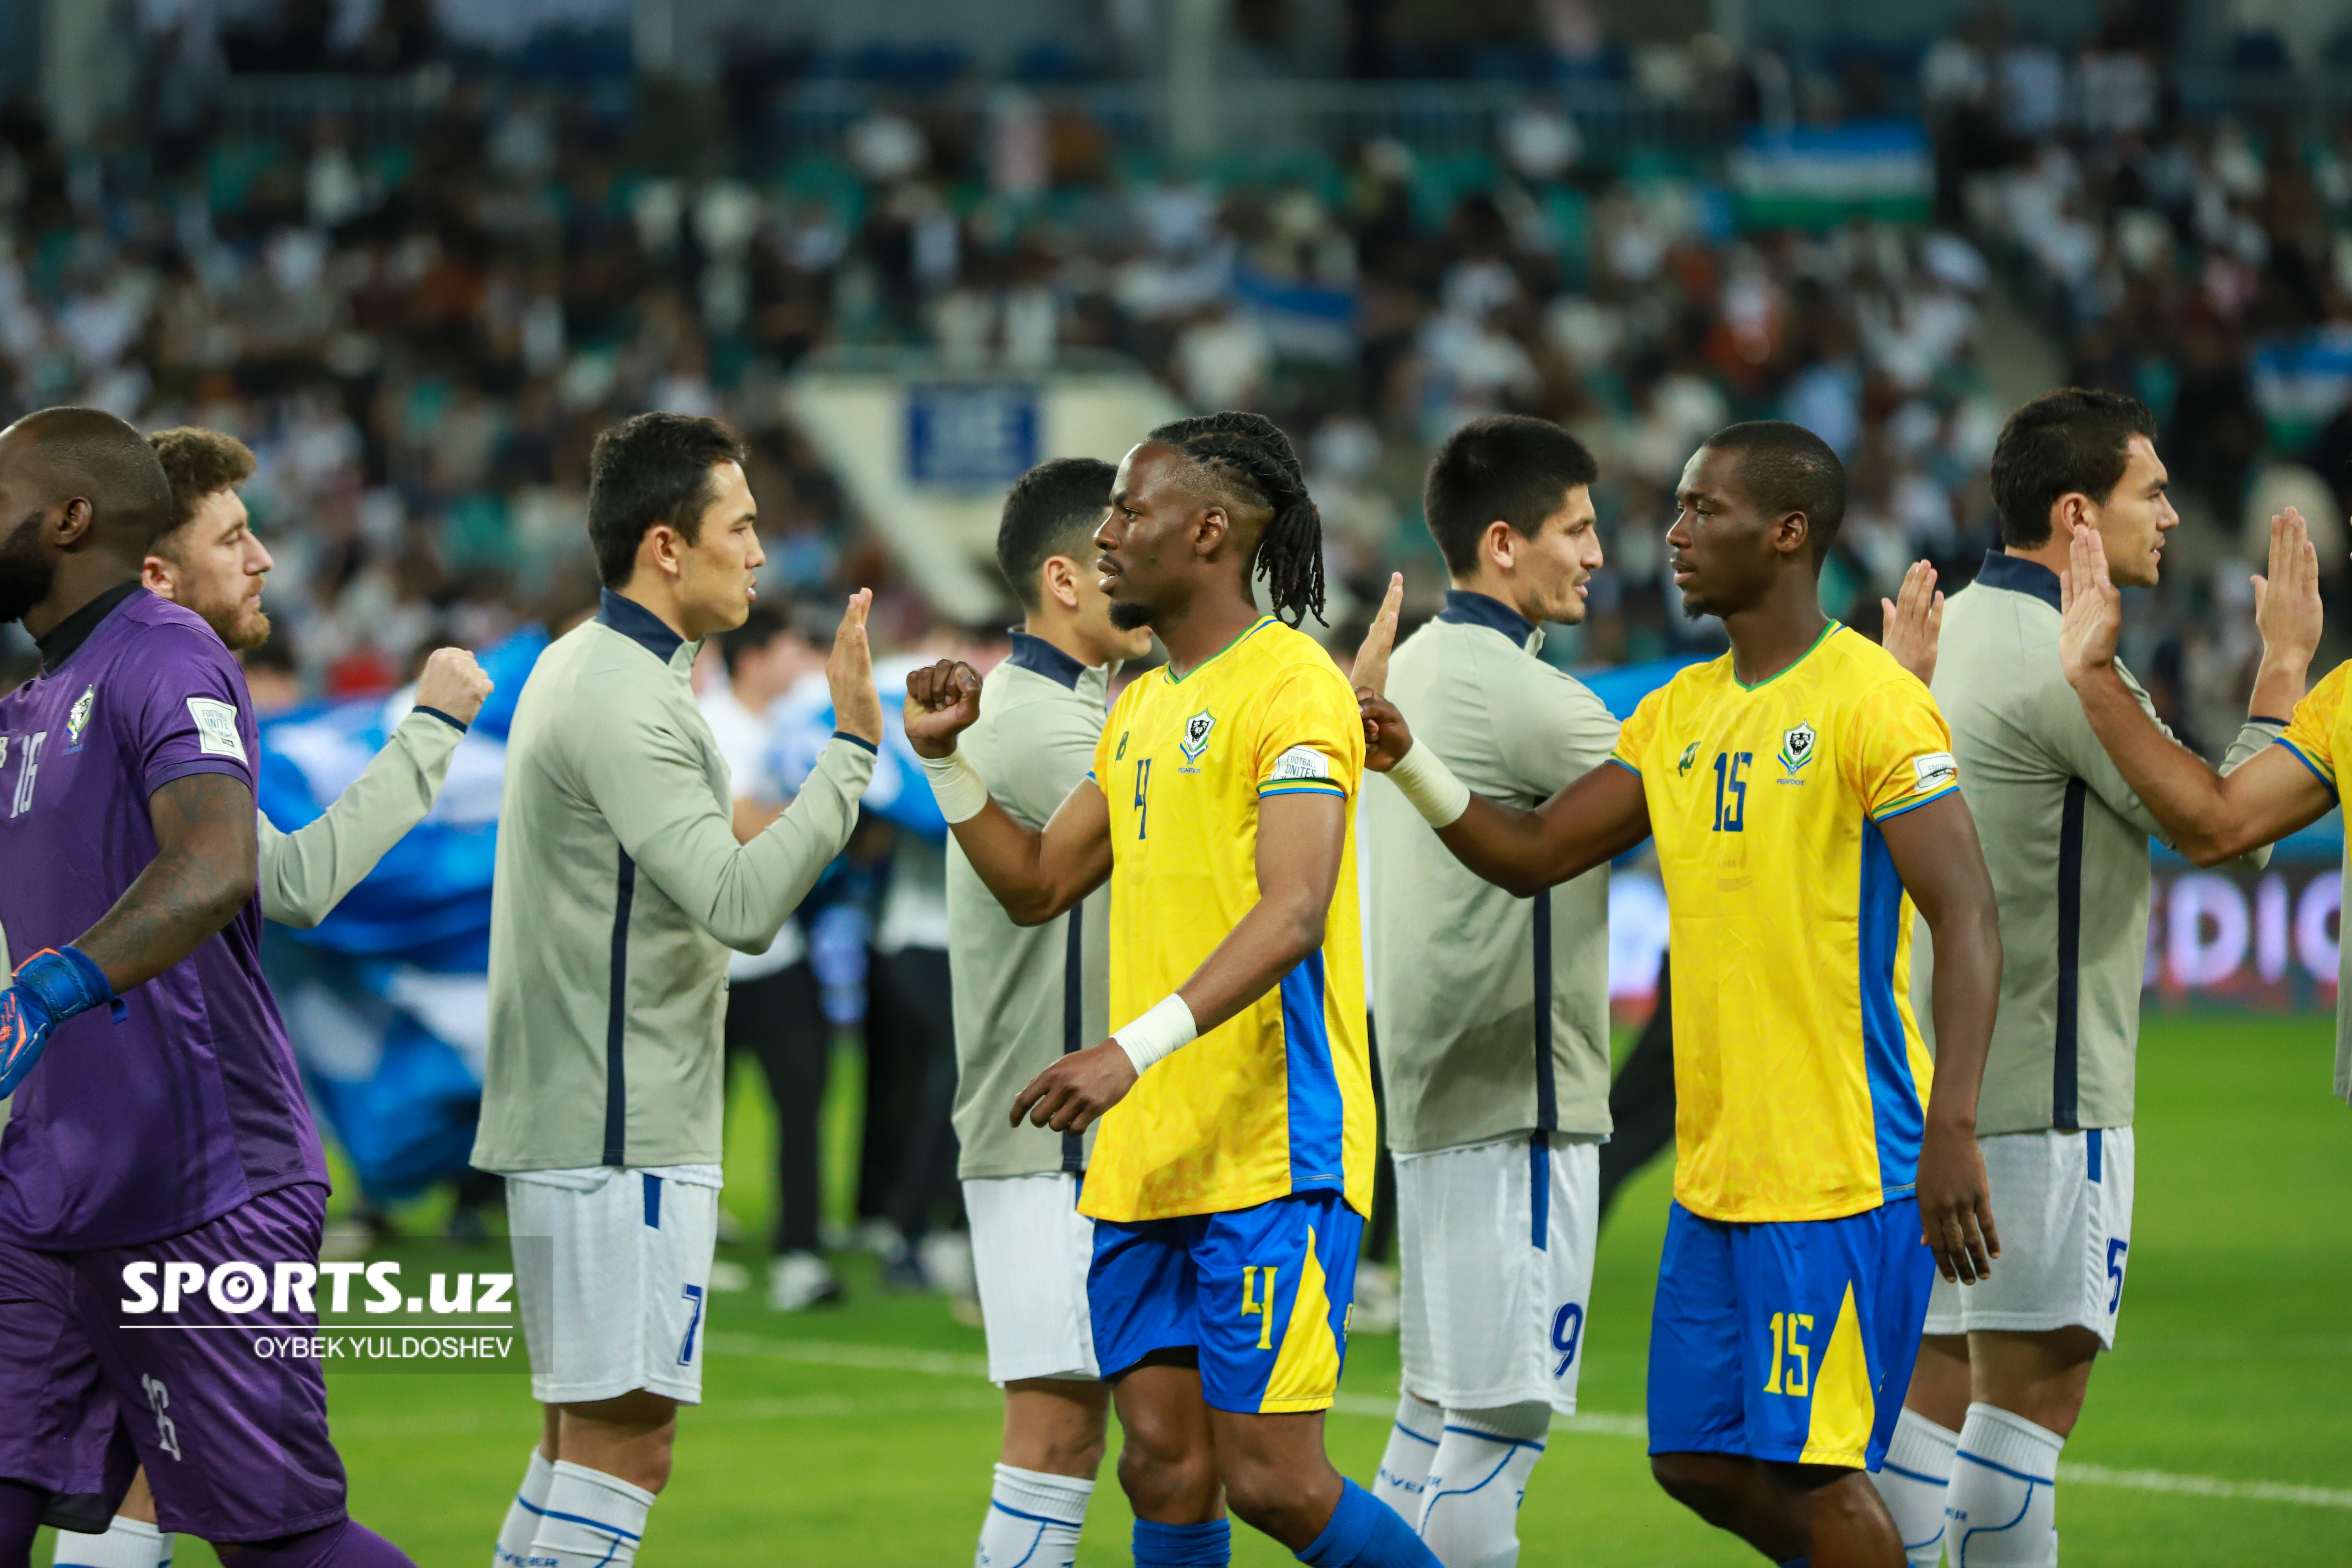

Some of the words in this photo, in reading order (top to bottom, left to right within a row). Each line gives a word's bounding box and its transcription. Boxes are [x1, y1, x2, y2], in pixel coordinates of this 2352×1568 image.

[9, 731, 47, 819] 16
[1134, 758, 1152, 840] 4
[1285, 764, 1317, 778] UNITES
[1286, 755, 1317, 769] FOOTBALL
[1712, 752, 1753, 832] 15
[1240, 1265, 1278, 1350] 4
[2105, 1236, 2128, 1317] 5
[677, 1283, 704, 1366] 7
[1550, 1302, 1583, 1380] 9
[1764, 1312, 1814, 1397] 15
